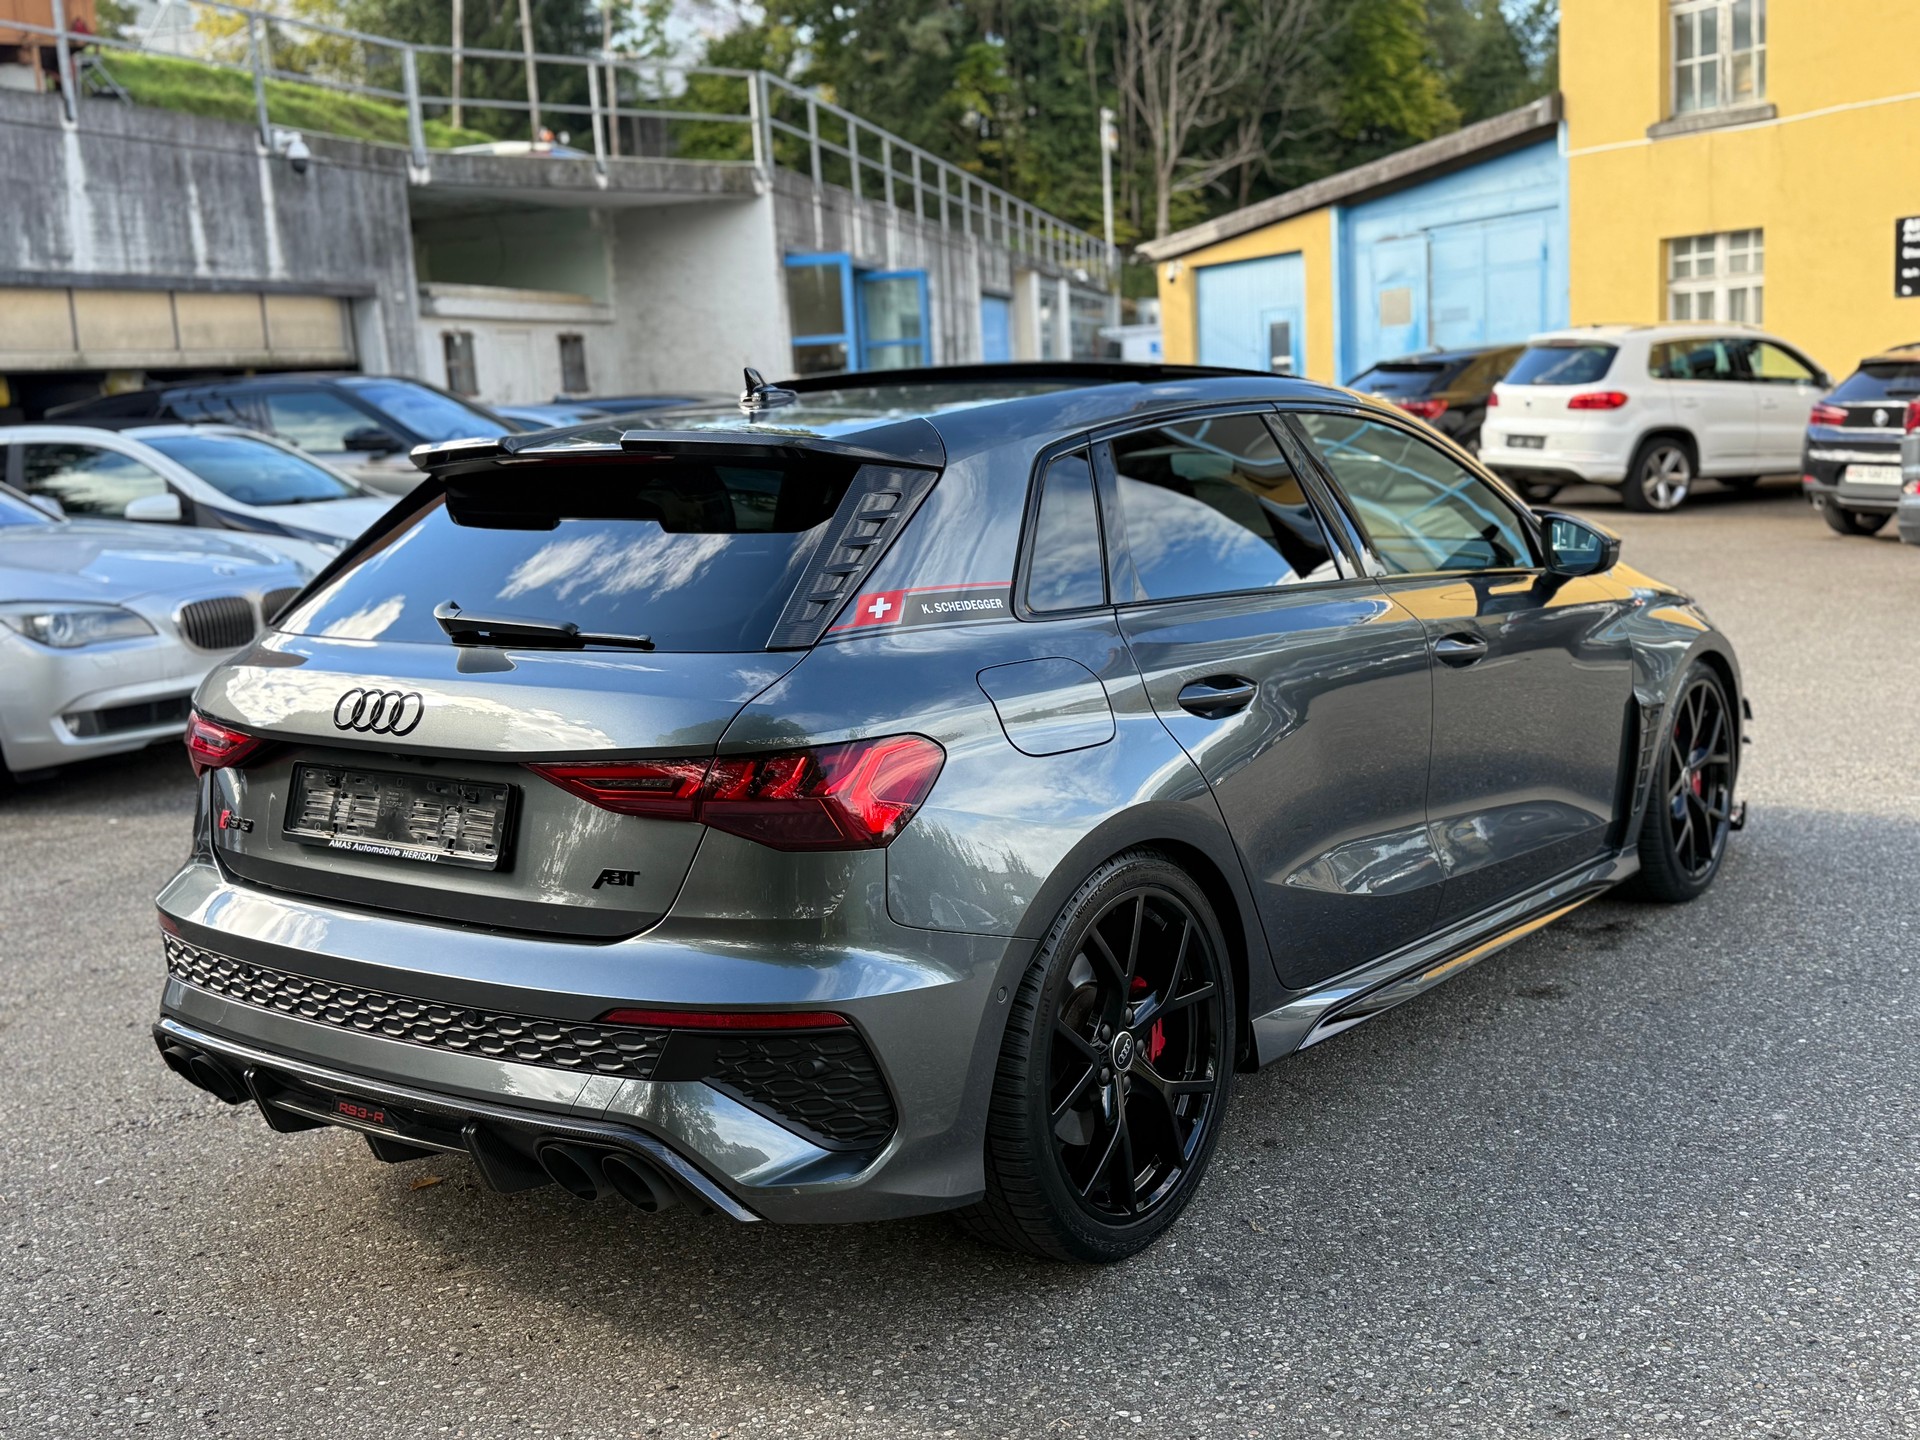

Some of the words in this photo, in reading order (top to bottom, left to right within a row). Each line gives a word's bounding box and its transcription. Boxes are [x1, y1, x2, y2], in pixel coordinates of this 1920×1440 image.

[921, 603, 934, 615] K.
[934, 599, 1003, 613] SCHEIDEGGER
[329, 839, 352, 850] AMAS
[352, 844, 401, 857] Automobile
[402, 849, 439, 862] HERISAU
[591, 868, 641, 890] ABT
[1074, 867, 1126, 919] WinterContact
[339, 1101, 385, 1124] RS3-R
